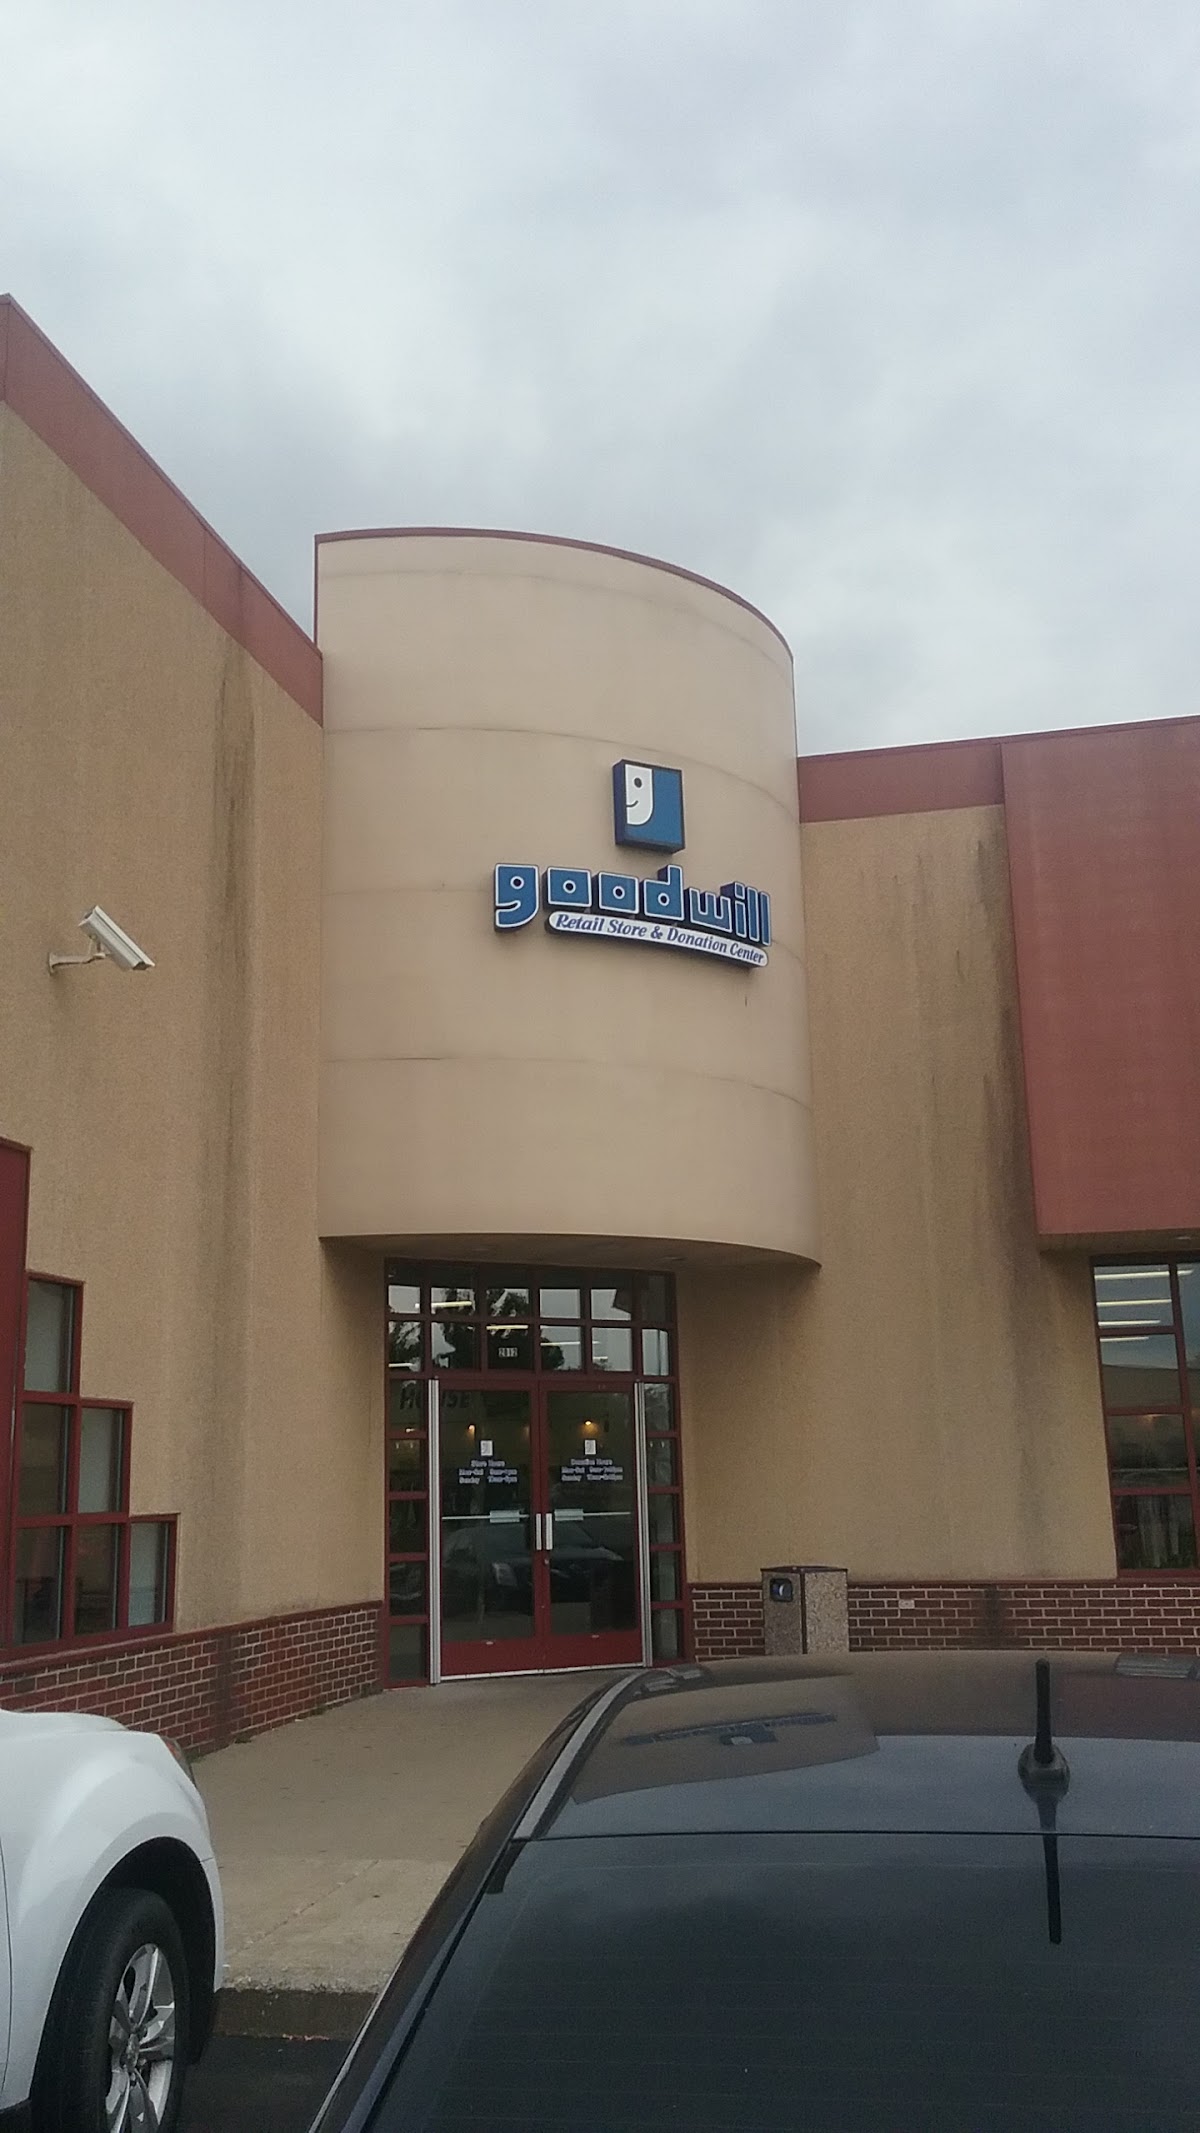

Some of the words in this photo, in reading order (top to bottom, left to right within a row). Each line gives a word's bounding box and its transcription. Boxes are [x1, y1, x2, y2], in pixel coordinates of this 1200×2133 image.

[494, 863, 771, 947] goodwill
[555, 913, 604, 932] Retail
[607, 918, 648, 937] Store
[650, 925, 663, 940] &
[666, 928, 728, 954] Donation
[729, 944, 765, 965] Center
